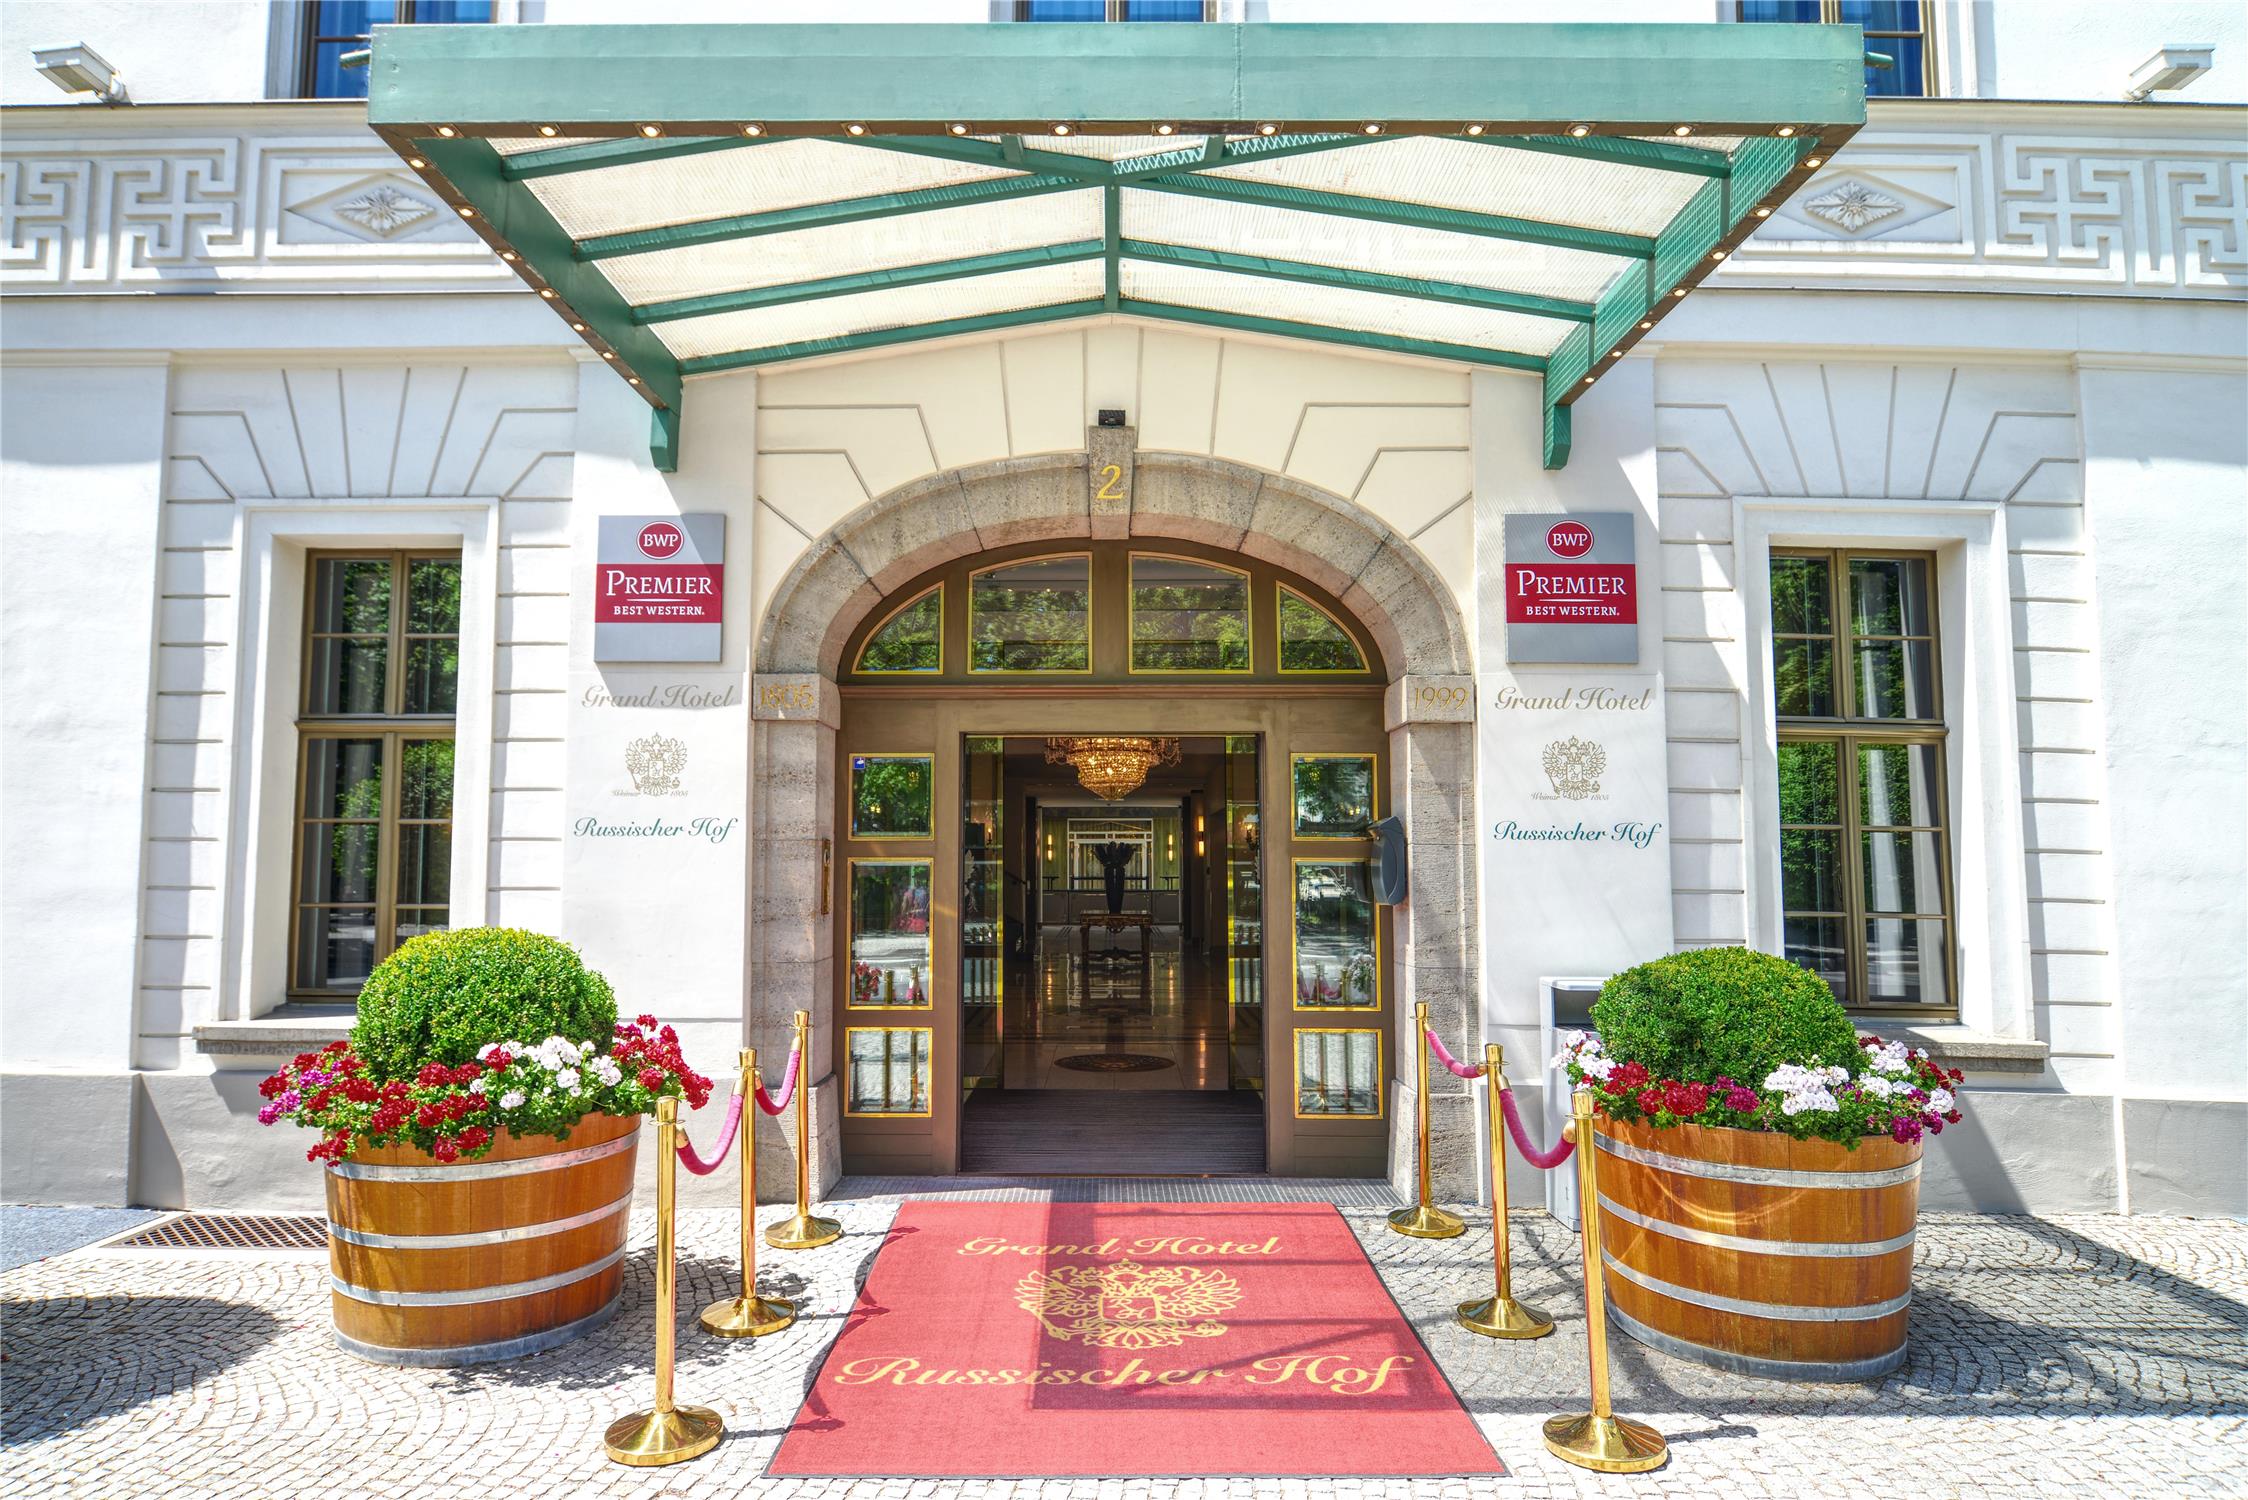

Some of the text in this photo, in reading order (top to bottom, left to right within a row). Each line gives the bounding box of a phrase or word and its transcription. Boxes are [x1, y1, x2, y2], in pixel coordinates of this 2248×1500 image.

[1096, 464, 1124, 500] 2
[643, 533, 679, 547] BWP
[1552, 533, 1588, 547] BWP
[606, 570, 713, 596] PREMIER
[1516, 569, 1628, 596] PREMIER
[613, 606, 643, 616] BEST
[1526, 606, 1557, 616] BEST
[581, 684, 735, 708] Grand Hotel
[757, 683, 815, 710] 1805
[1414, 686, 1470, 712] 1999
[1494, 686, 1652, 710] Grand Hotel
[573, 816, 738, 844] Russischer Hof
[1493, 820, 1662, 849] Russischer Hof
[957, 1236, 1284, 1256] Grand Hotel
[834, 1354, 1414, 1396] Russischer Hof
